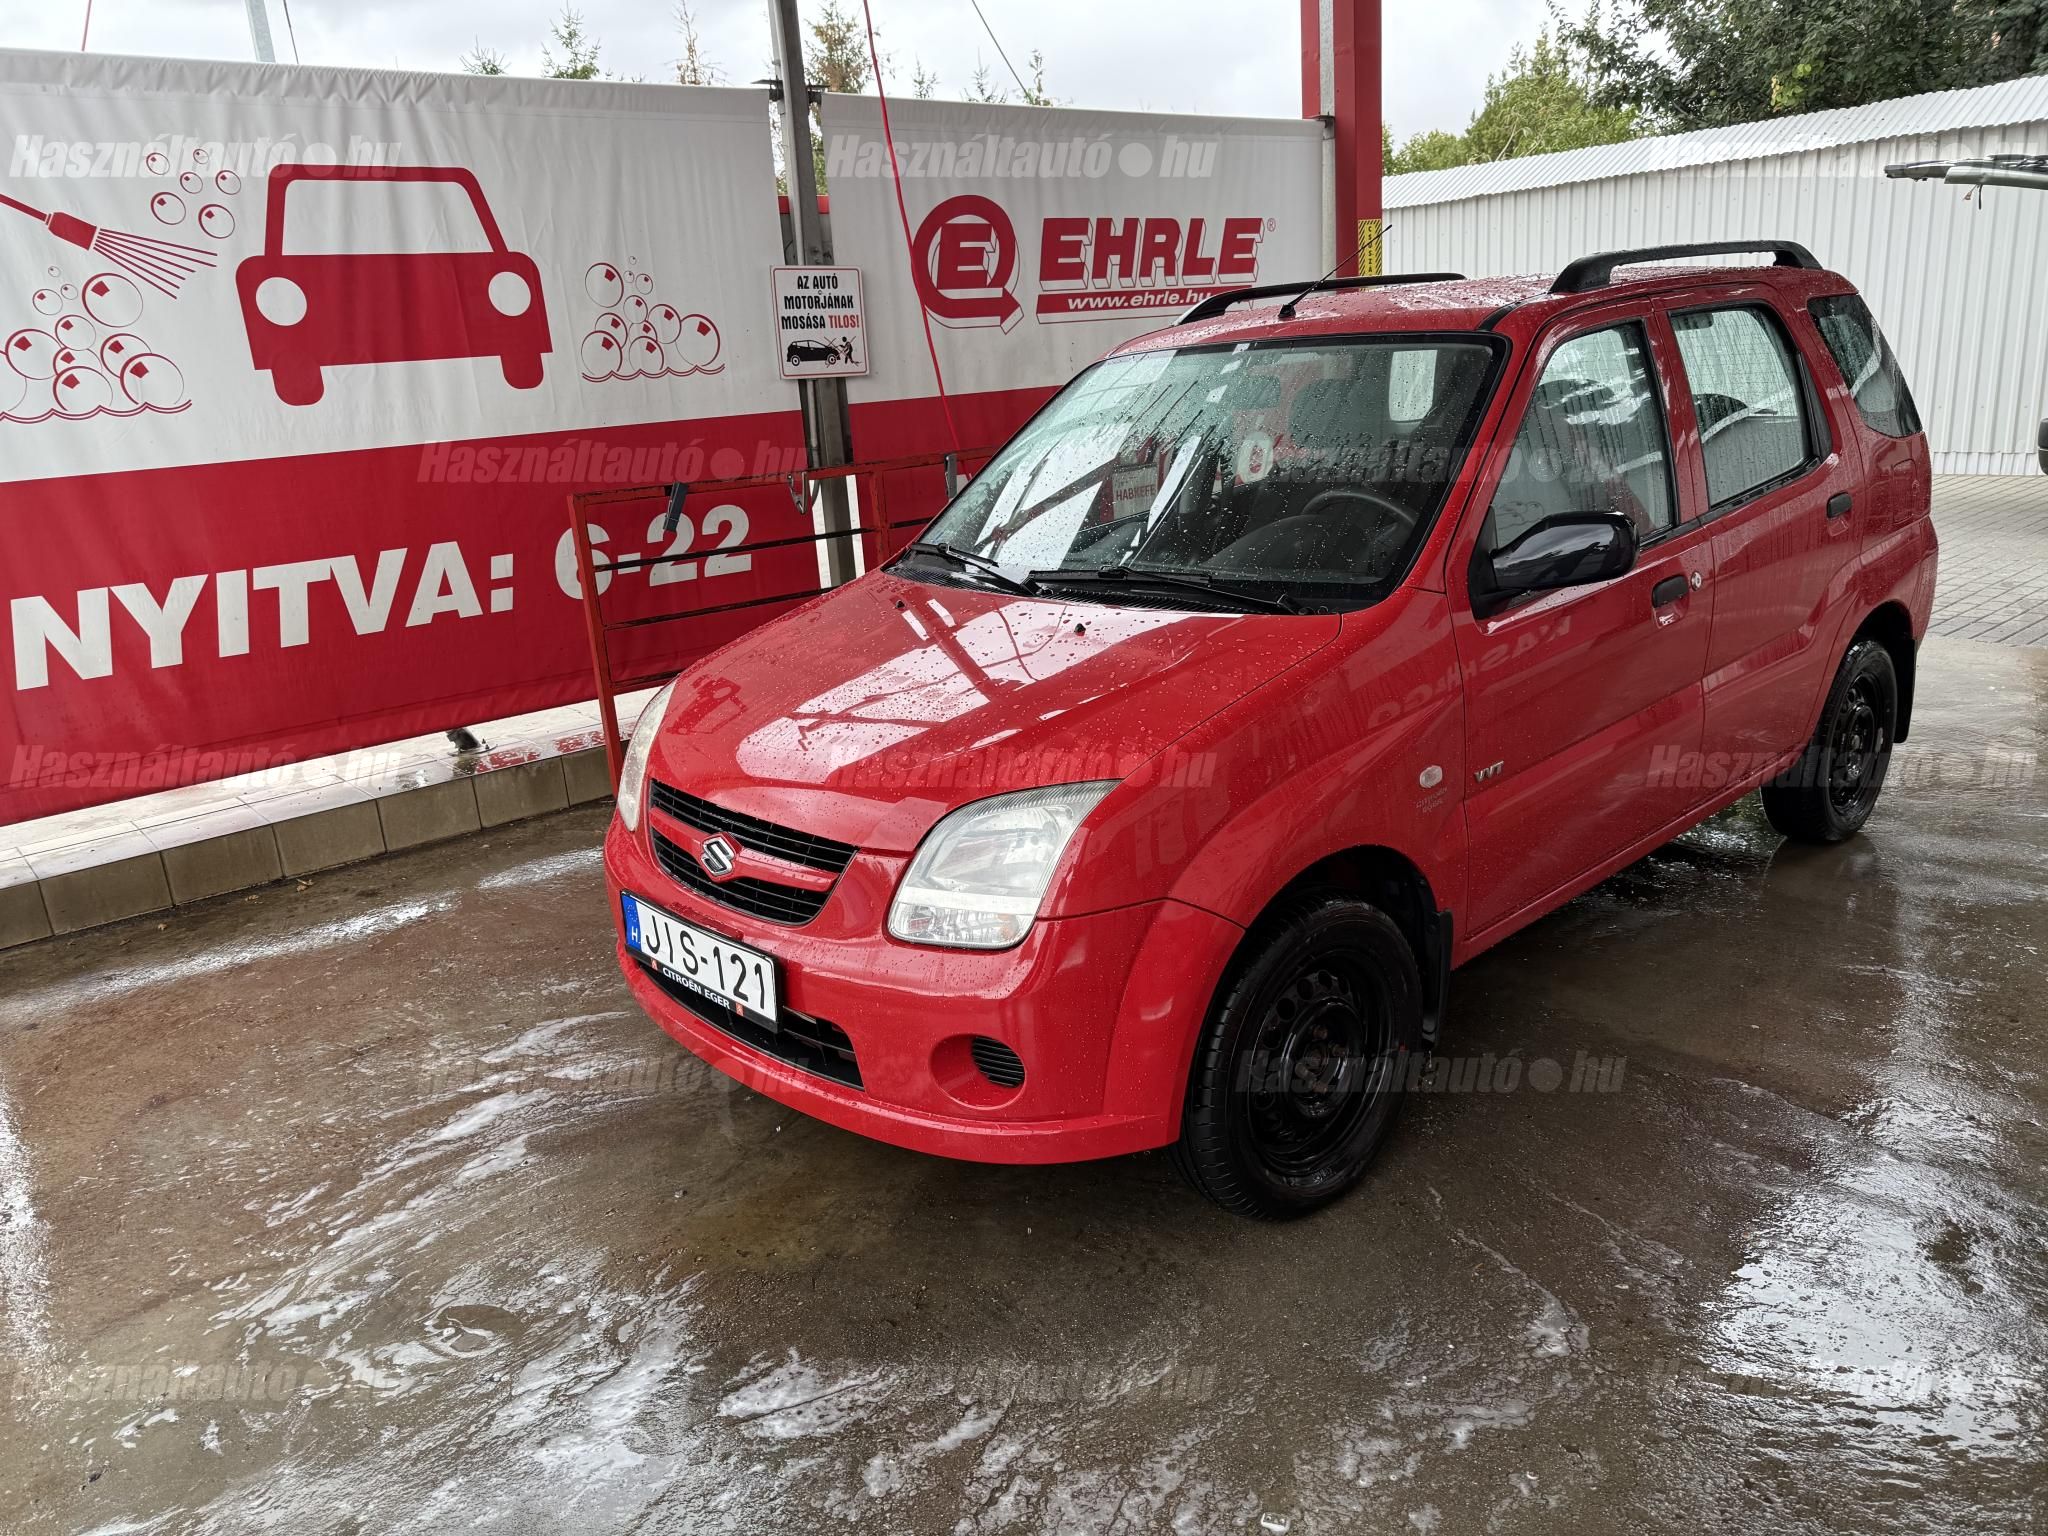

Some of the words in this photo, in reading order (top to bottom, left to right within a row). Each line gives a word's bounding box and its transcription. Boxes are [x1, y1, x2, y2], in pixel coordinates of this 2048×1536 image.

[1039, 217, 1265, 291] EHRLE
[797, 275, 810, 290] AZ
[812, 273, 839, 290] AUTÓ
[784, 292, 854, 310] MOTORJÁNAK
[1068, 289, 1212, 310] www.ehrle.hu
[781, 312, 826, 330] MOSÁSA
[828, 314, 860, 329] TILOS!
[10, 541, 514, 691] NYITVA:
[555, 504, 752, 600] 6-22
[631, 926, 639, 943] H
[645, 915, 766, 1010] JIS-121
[662, 967, 702, 996] CITROËN
[704, 989, 731, 1010] EGER
